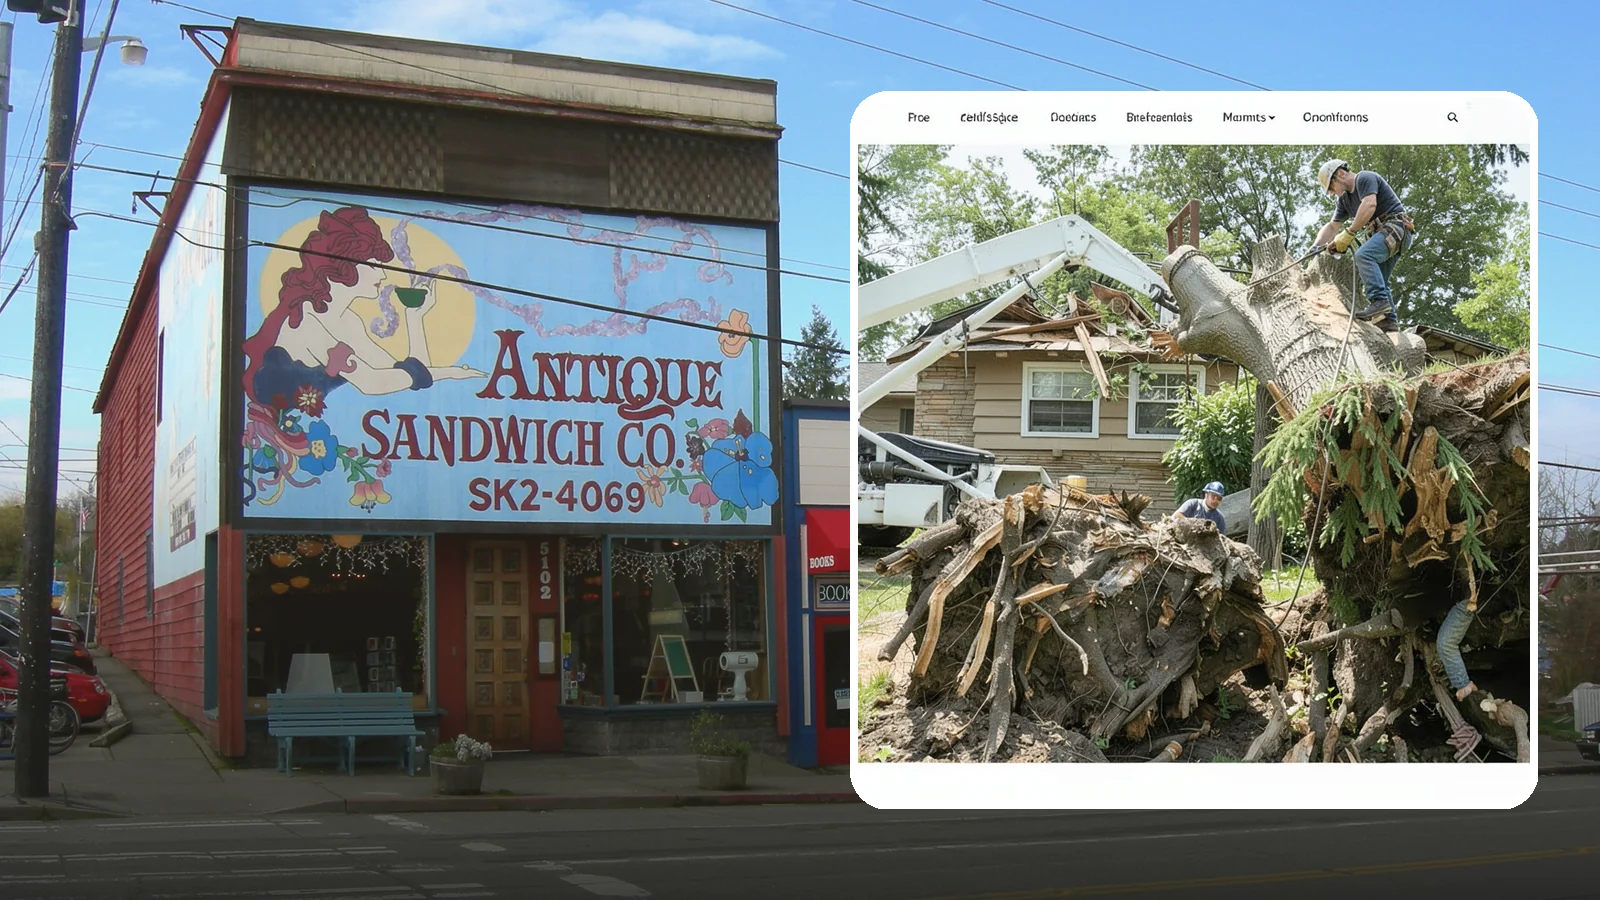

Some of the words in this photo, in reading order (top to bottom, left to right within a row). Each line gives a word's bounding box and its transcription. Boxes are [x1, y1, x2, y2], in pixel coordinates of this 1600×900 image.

[476, 329, 723, 420] ANTIQUE
[362, 408, 604, 466] SANDWICH
[617, 422, 684, 468] CO.
[468, 477, 645, 512] SK2-4069
[540, 542, 551, 599] 5102
[809, 555, 835, 568] BOOKS
